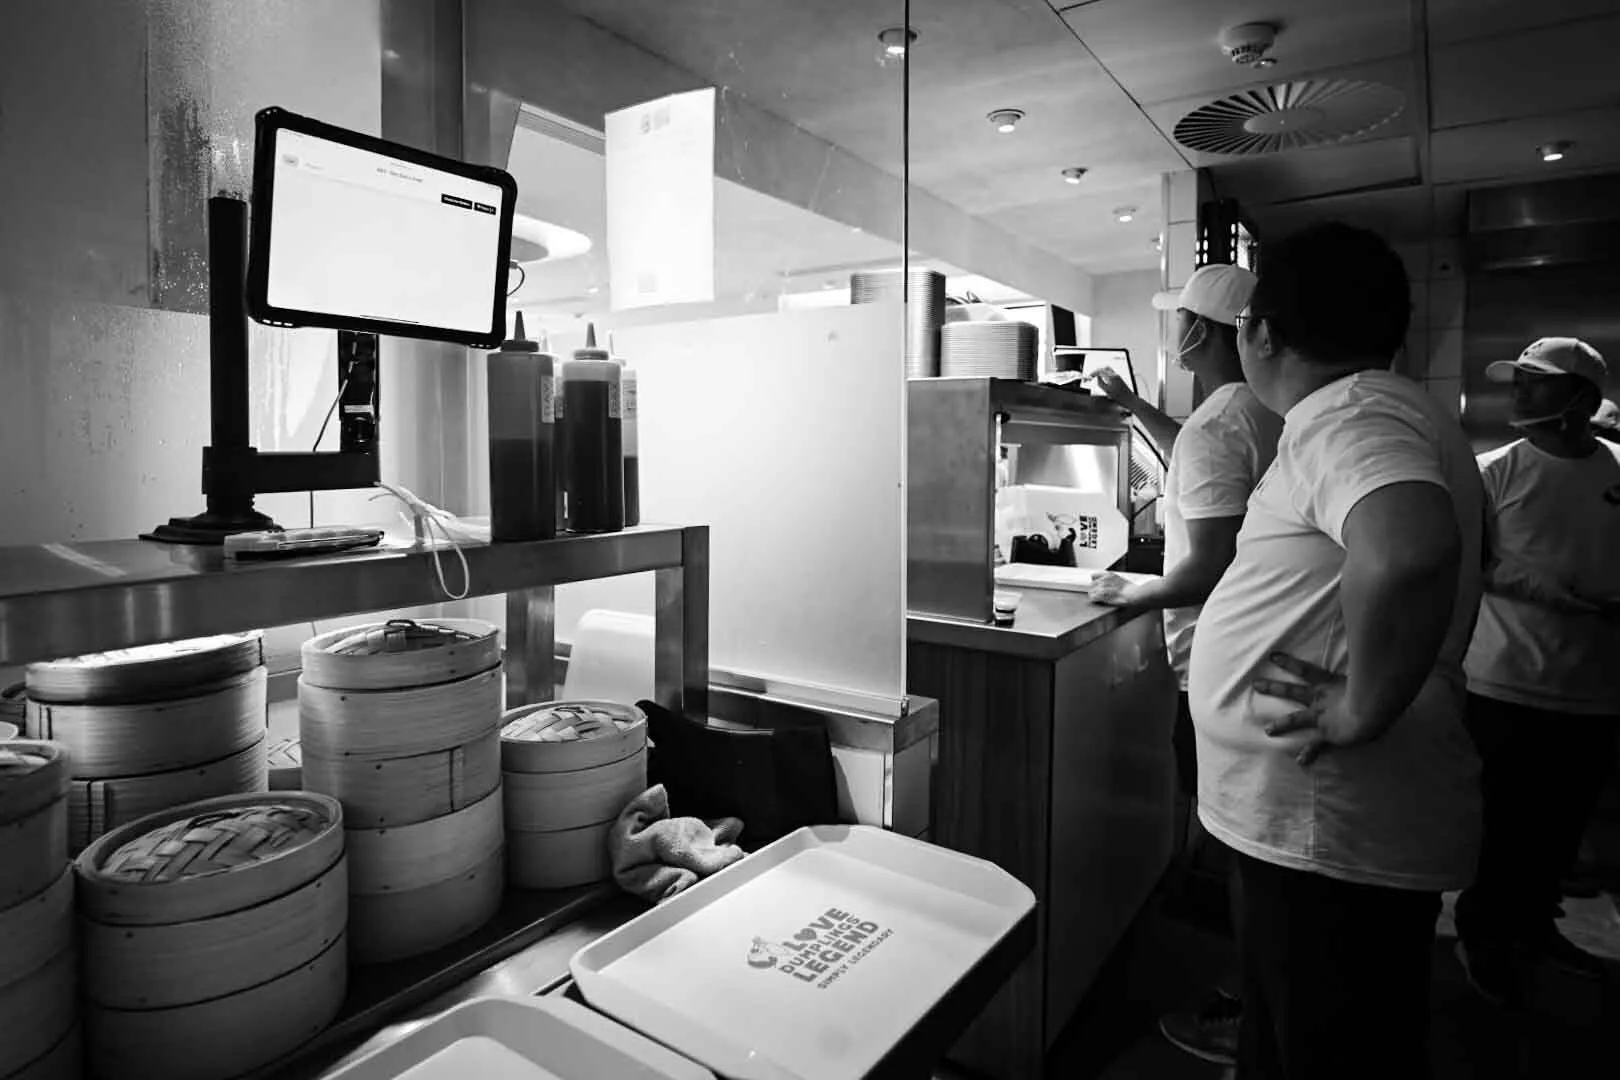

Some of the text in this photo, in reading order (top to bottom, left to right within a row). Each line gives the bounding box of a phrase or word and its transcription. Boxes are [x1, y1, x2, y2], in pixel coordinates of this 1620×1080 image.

[779, 914, 861, 974] DUMPLINGS
[792, 921, 879, 982] LEGEND
[816, 928, 894, 989] SIMPLY LEGENDARY
